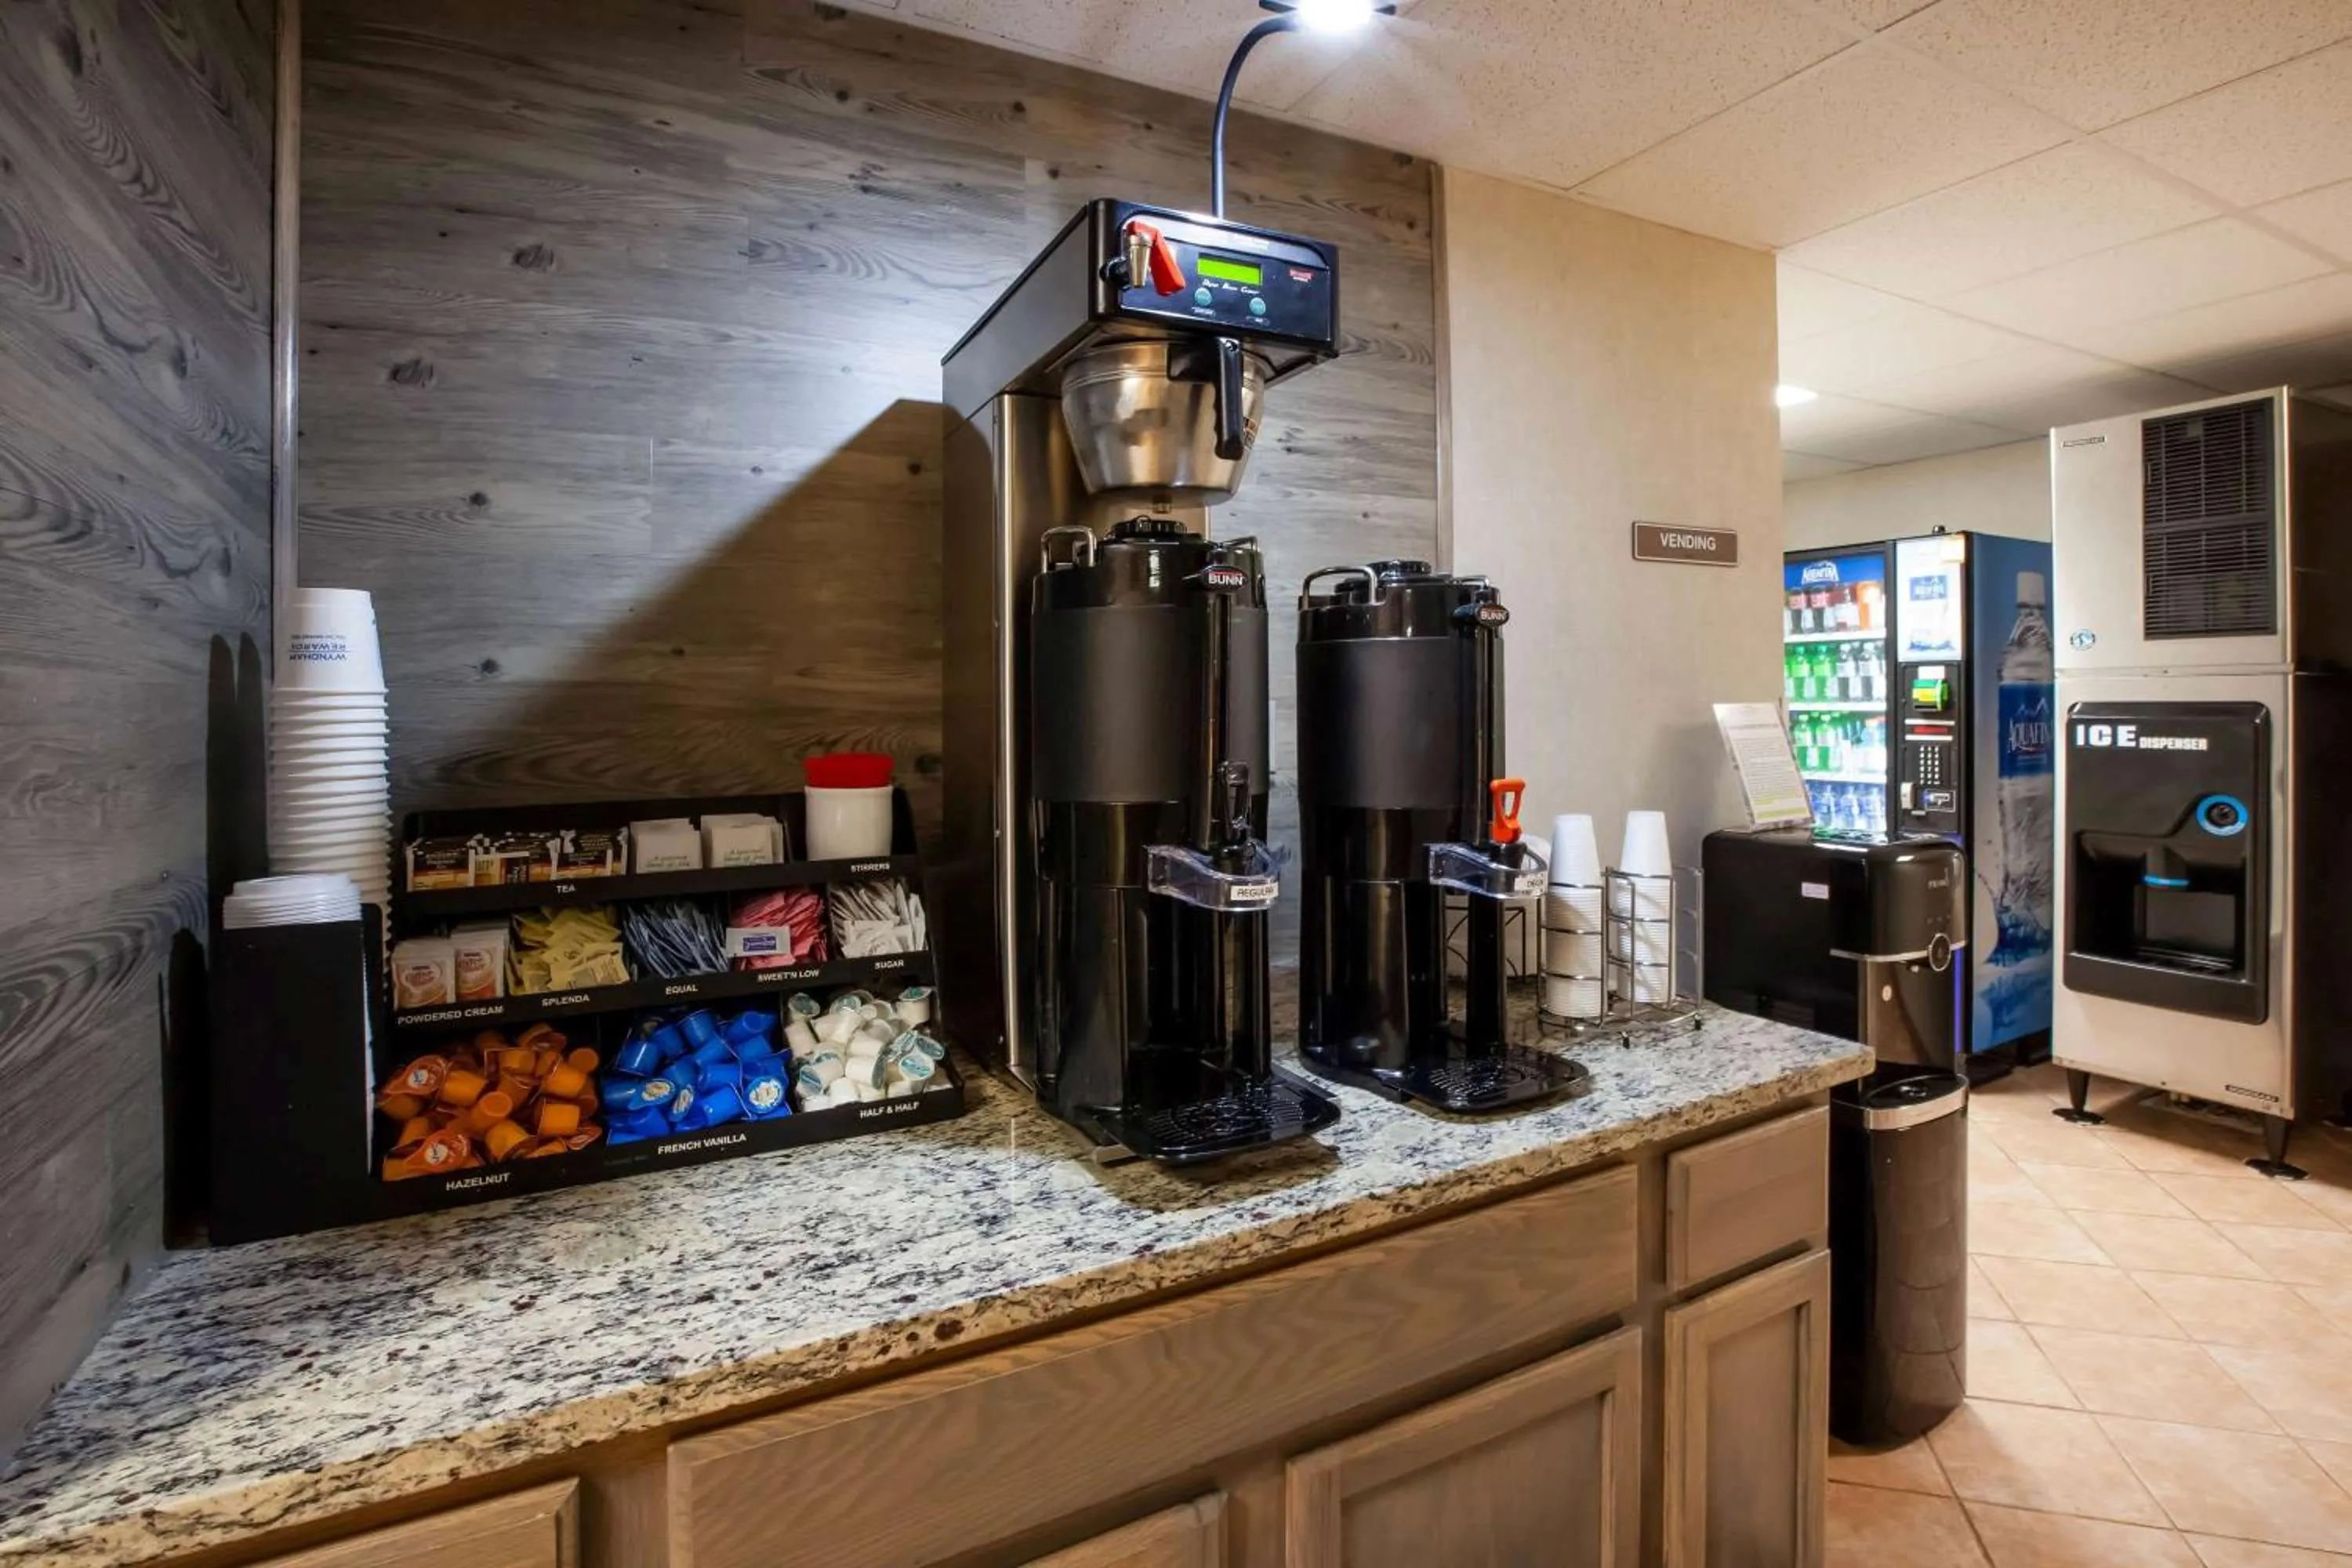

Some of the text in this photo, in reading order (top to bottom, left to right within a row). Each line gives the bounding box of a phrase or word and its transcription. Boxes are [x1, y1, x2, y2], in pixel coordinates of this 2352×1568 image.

[1660, 533, 1716, 550] VENDING
[1208, 572, 1243, 586] BUNN
[2008, 718, 2054, 753] AQUAFIN
[2076, 724, 2208, 751] ICE DISPENSER
[556, 884, 575, 894] TEA
[799, 968, 819, 978] LOW
[874, 959, 904, 970] SUGAR
[666, 984, 699, 995] EQUAL
[542, 993, 590, 1007] SPLENDA
[397, 1005, 503, 1025] POWDERED CREAM
[859, 1106, 885, 1120] HALF
[895, 1101, 920, 1113] HALF
[658, 1133, 747, 1155] FRENCH VANILLA
[445, 1172, 511, 1191] HAZELNUT
